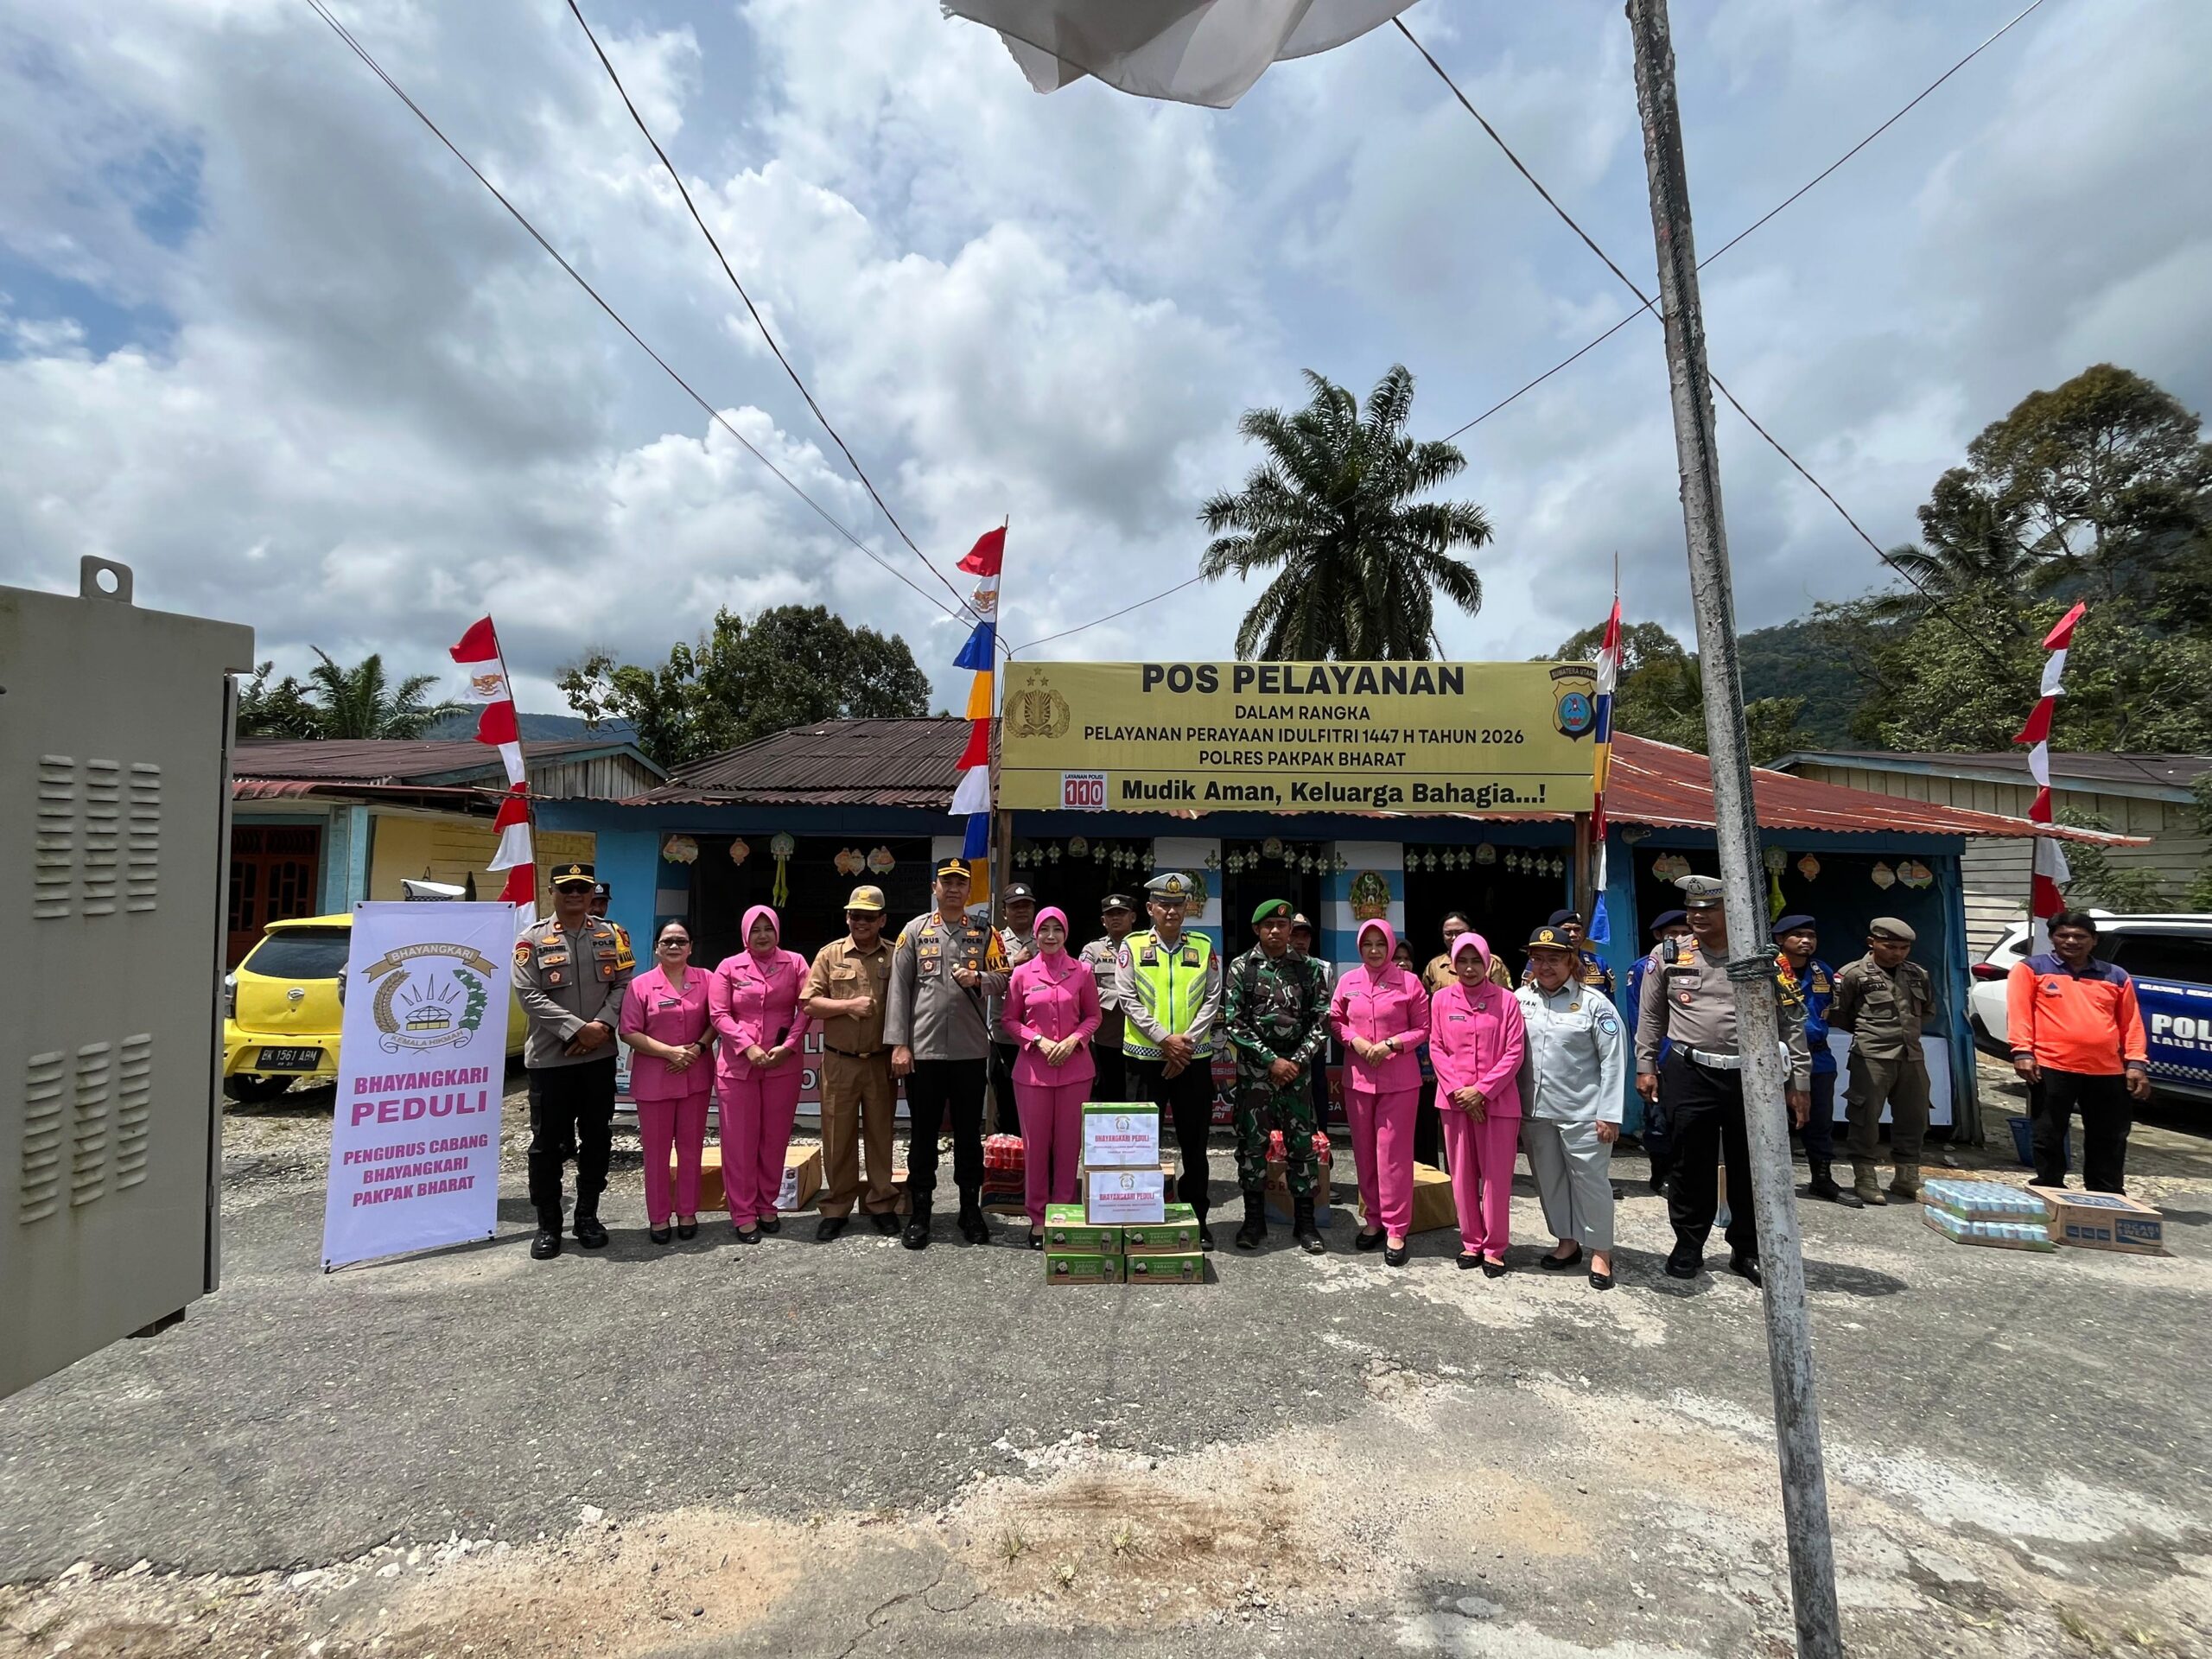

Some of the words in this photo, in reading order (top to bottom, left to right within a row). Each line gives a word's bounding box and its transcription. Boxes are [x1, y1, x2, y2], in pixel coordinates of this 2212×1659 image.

[1142, 664, 1219, 693] POS
[1233, 665, 1465, 695] PELAYANAN
[1552, 667, 1580, 678] SUMATERA
[1580, 669, 1597, 679] UTARA
[1235, 705, 1294, 720] DALAM
[1299, 706, 1370, 721] RANGKA
[1084, 726, 1182, 741] PELAYANAN
[1186, 728, 1274, 742] PERAYAAN
[1279, 728, 1359, 743] IDULFITRI
[1363, 728, 1399, 743] 1447
[1403, 729, 1414, 743] H
[1419, 729, 1477, 744] TAHUN
[1481, 729, 1524, 744] 2026
[1199, 750, 1263, 766] POLRES
[1268, 752, 1335, 766] PAKPAK
[1338, 752, 1407, 766] BHARAT
[1066, 784, 1102, 803] 110
[1122, 779, 1197, 800] Mudik
[1204, 781, 1282, 806] Aman,
[1291, 781, 1403, 808] Keluarga
[1412, 782, 1546, 809] Bahagia...!
[391, 944, 474, 962] BHAYANGKARI
[390, 1034, 428, 1046] KEMALA
[429, 1031, 464, 1046] HIKMAH
[2152, 1035, 2195, 1049] LALU
[261, 1049, 273, 1061] BK
[276, 1050, 297, 1061] 1561
[353, 1066, 489, 1095] BHAYANGKARI
[351, 1090, 487, 1127] PEDULI
[343, 1141, 426, 1166] PENGURUS
[429, 1134, 488, 1154] CABANG
[363, 1156, 469, 1185] BHAYANGKARI
[353, 1185, 415, 1207] PAKPAK
[416, 1176, 475, 1197] BHARAT
[2116, 1223, 2159, 1233] POCARI
[2117, 1228, 2156, 1238] SWEAT
